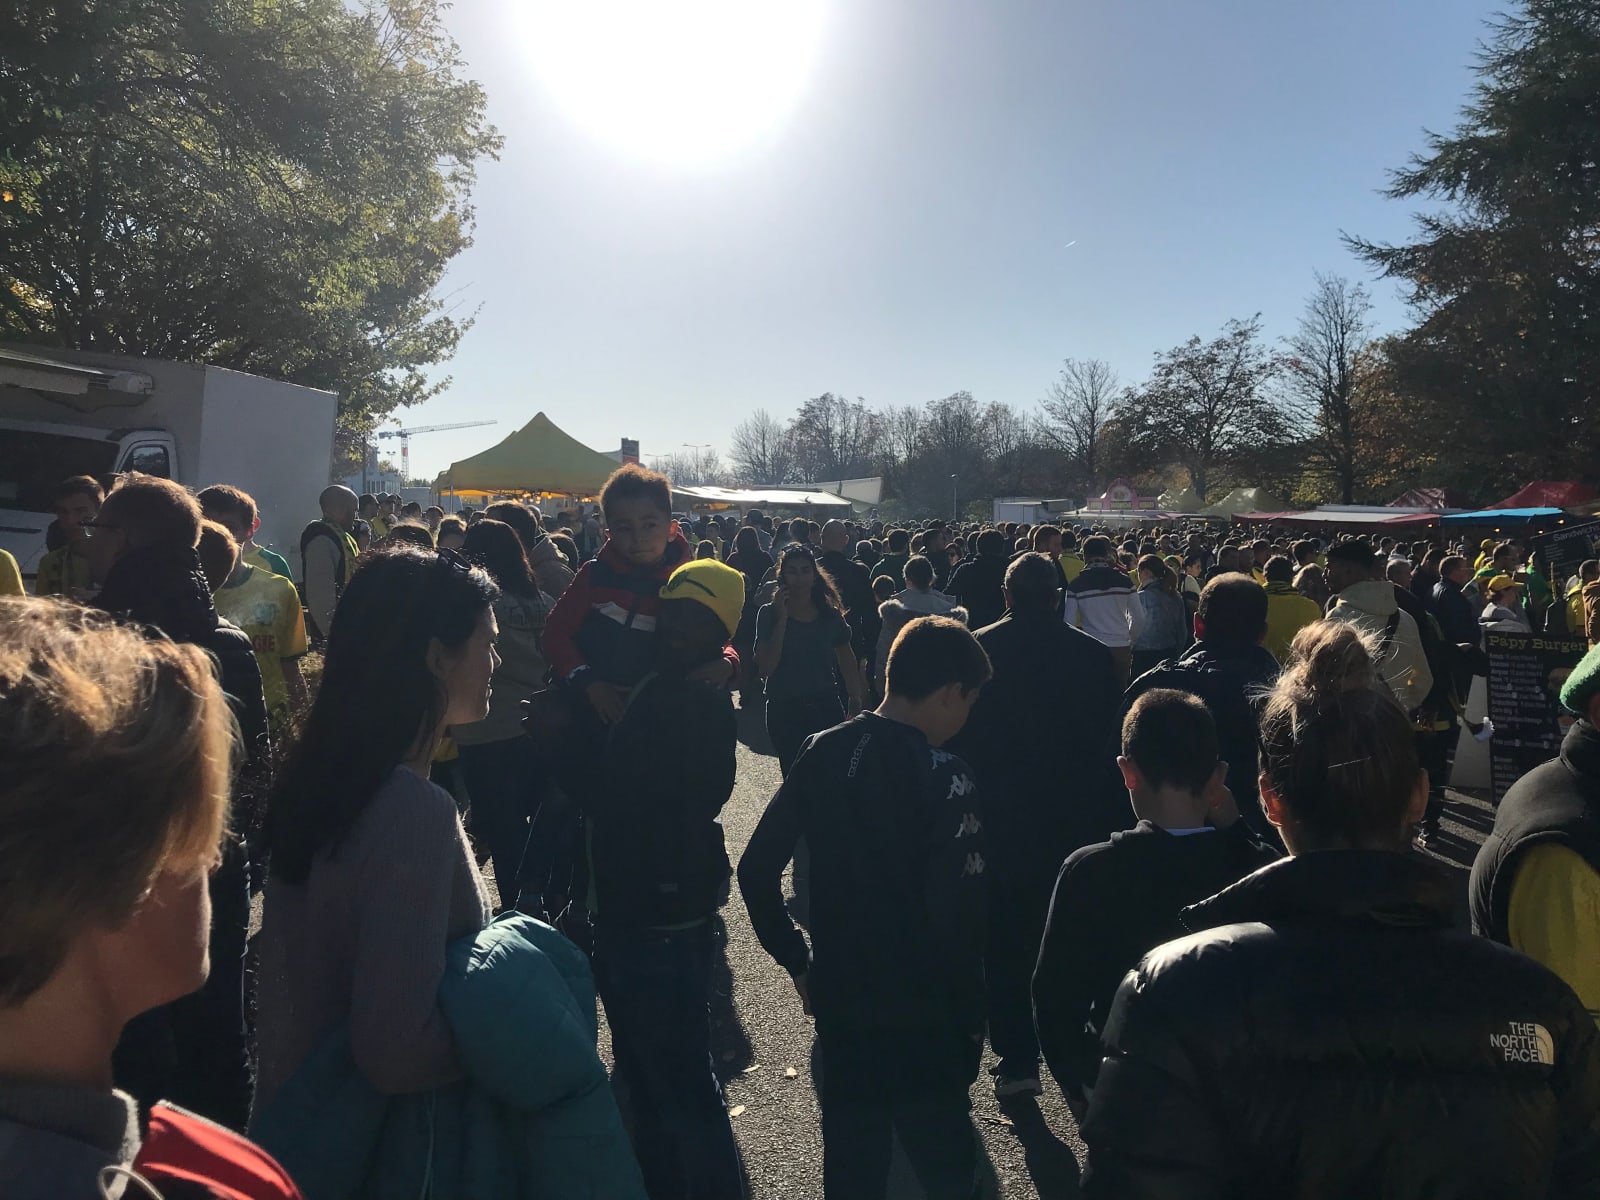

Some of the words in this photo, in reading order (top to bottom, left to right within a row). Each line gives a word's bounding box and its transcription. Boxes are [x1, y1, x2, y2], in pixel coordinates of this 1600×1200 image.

[1488, 635, 1528, 650] Papy
[1532, 638, 1587, 653] Burger
[1509, 1021, 1535, 1036] THE
[1489, 1033, 1538, 1050] NORTH
[1504, 1048, 1539, 1063] FACE
